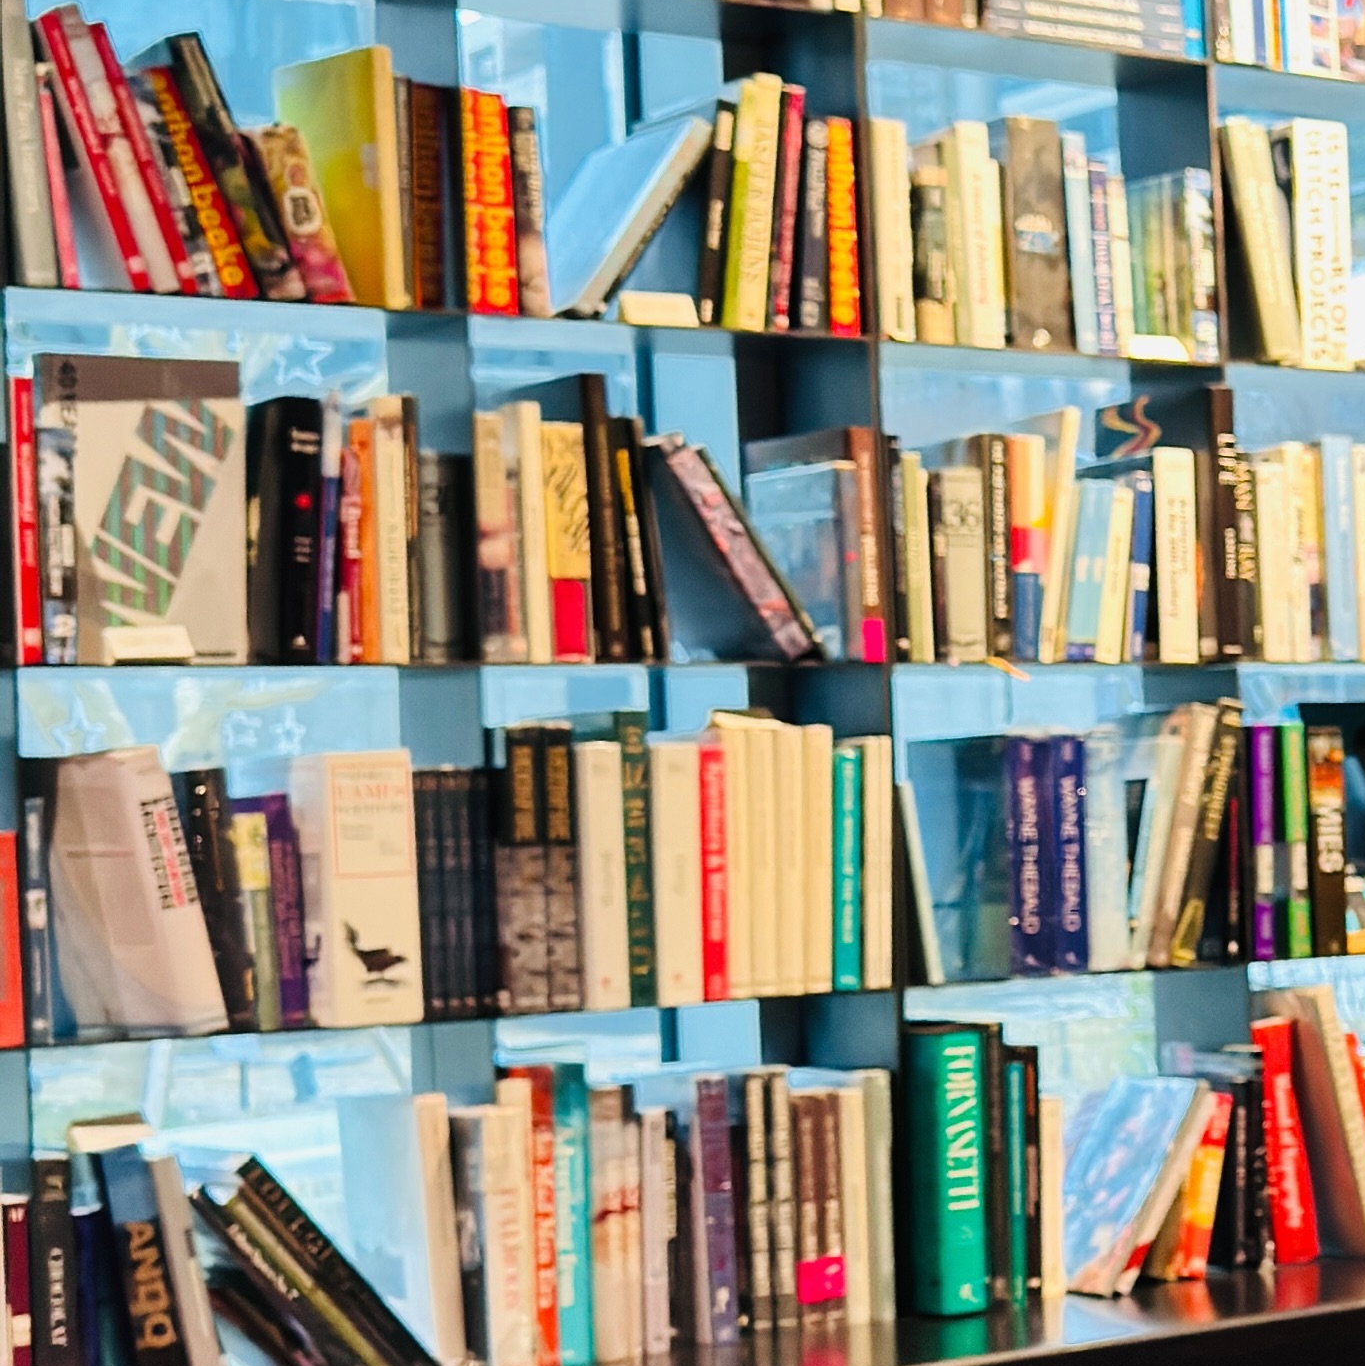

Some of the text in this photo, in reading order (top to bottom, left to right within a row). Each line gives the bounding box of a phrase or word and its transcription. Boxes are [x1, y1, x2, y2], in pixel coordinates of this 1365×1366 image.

[476, 95, 516, 308] anthon beeke
[1314, 803, 1344, 873] MIES
